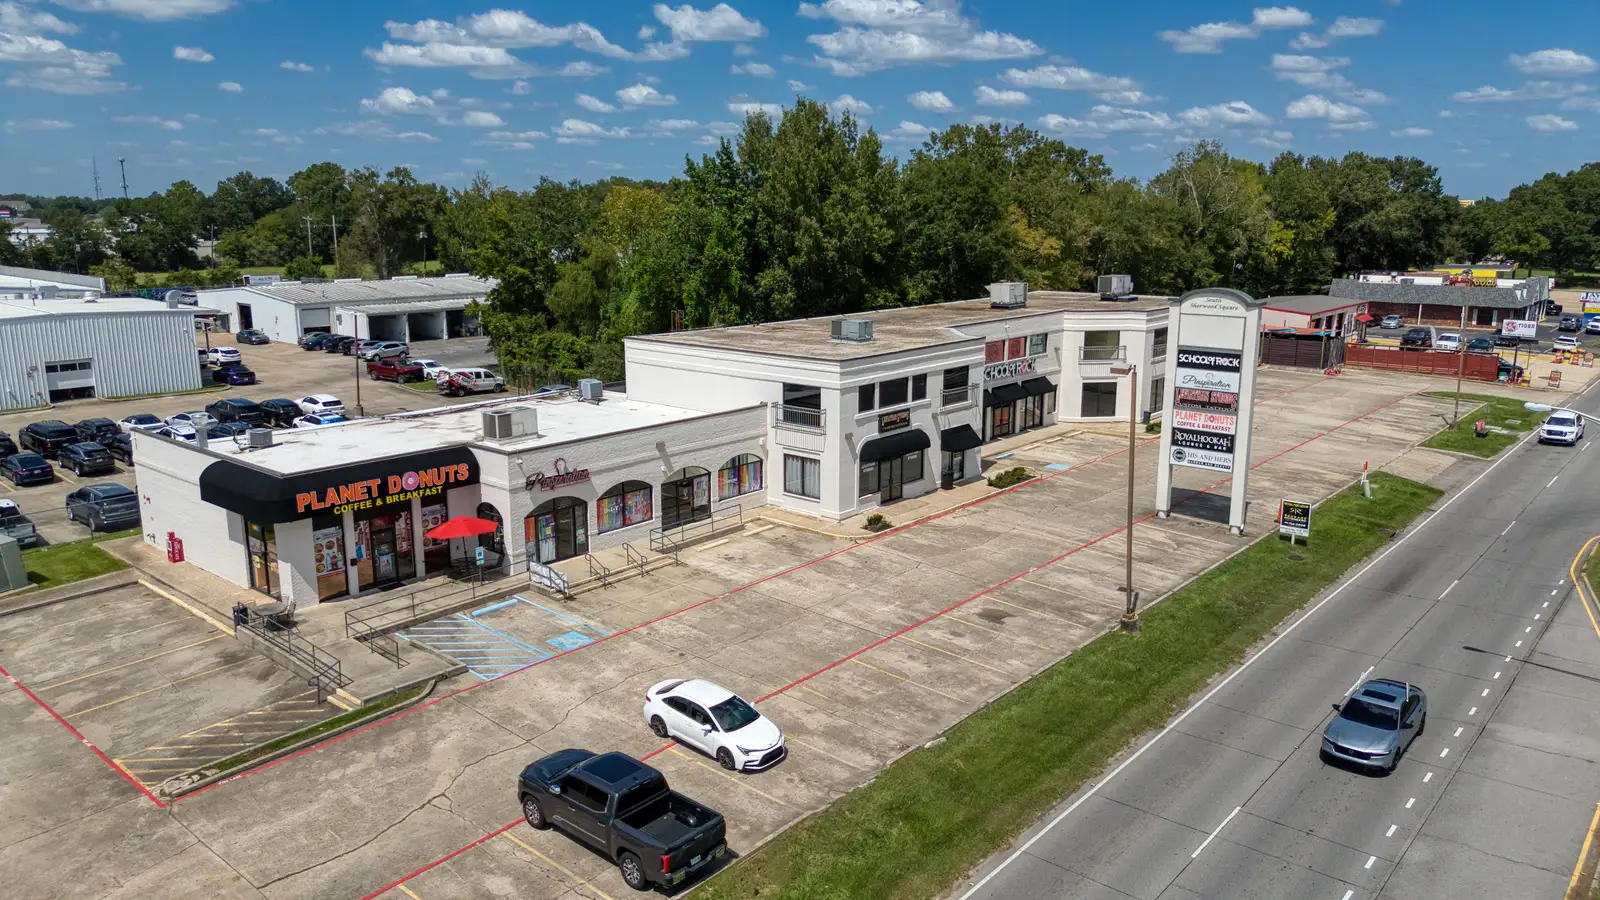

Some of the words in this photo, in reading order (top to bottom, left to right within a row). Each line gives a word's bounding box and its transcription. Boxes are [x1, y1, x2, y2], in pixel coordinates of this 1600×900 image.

[1182, 374, 1231, 388] Pinspiration
[1175, 411, 1202, 422] PLANET
[1204, 413, 1235, 426] DONUTS
[1201, 424, 1231, 432] BREAKFAST
[1199, 453, 1213, 461] AND
[1214, 454, 1232, 463] HERS
[296, 478, 381, 513] PLANET
[388, 463, 470, 494] DONUTS
[333, 499, 373, 515] COFFEE
[375, 498, 384, 507] &
[386, 485, 443, 504] BREAKFAST
